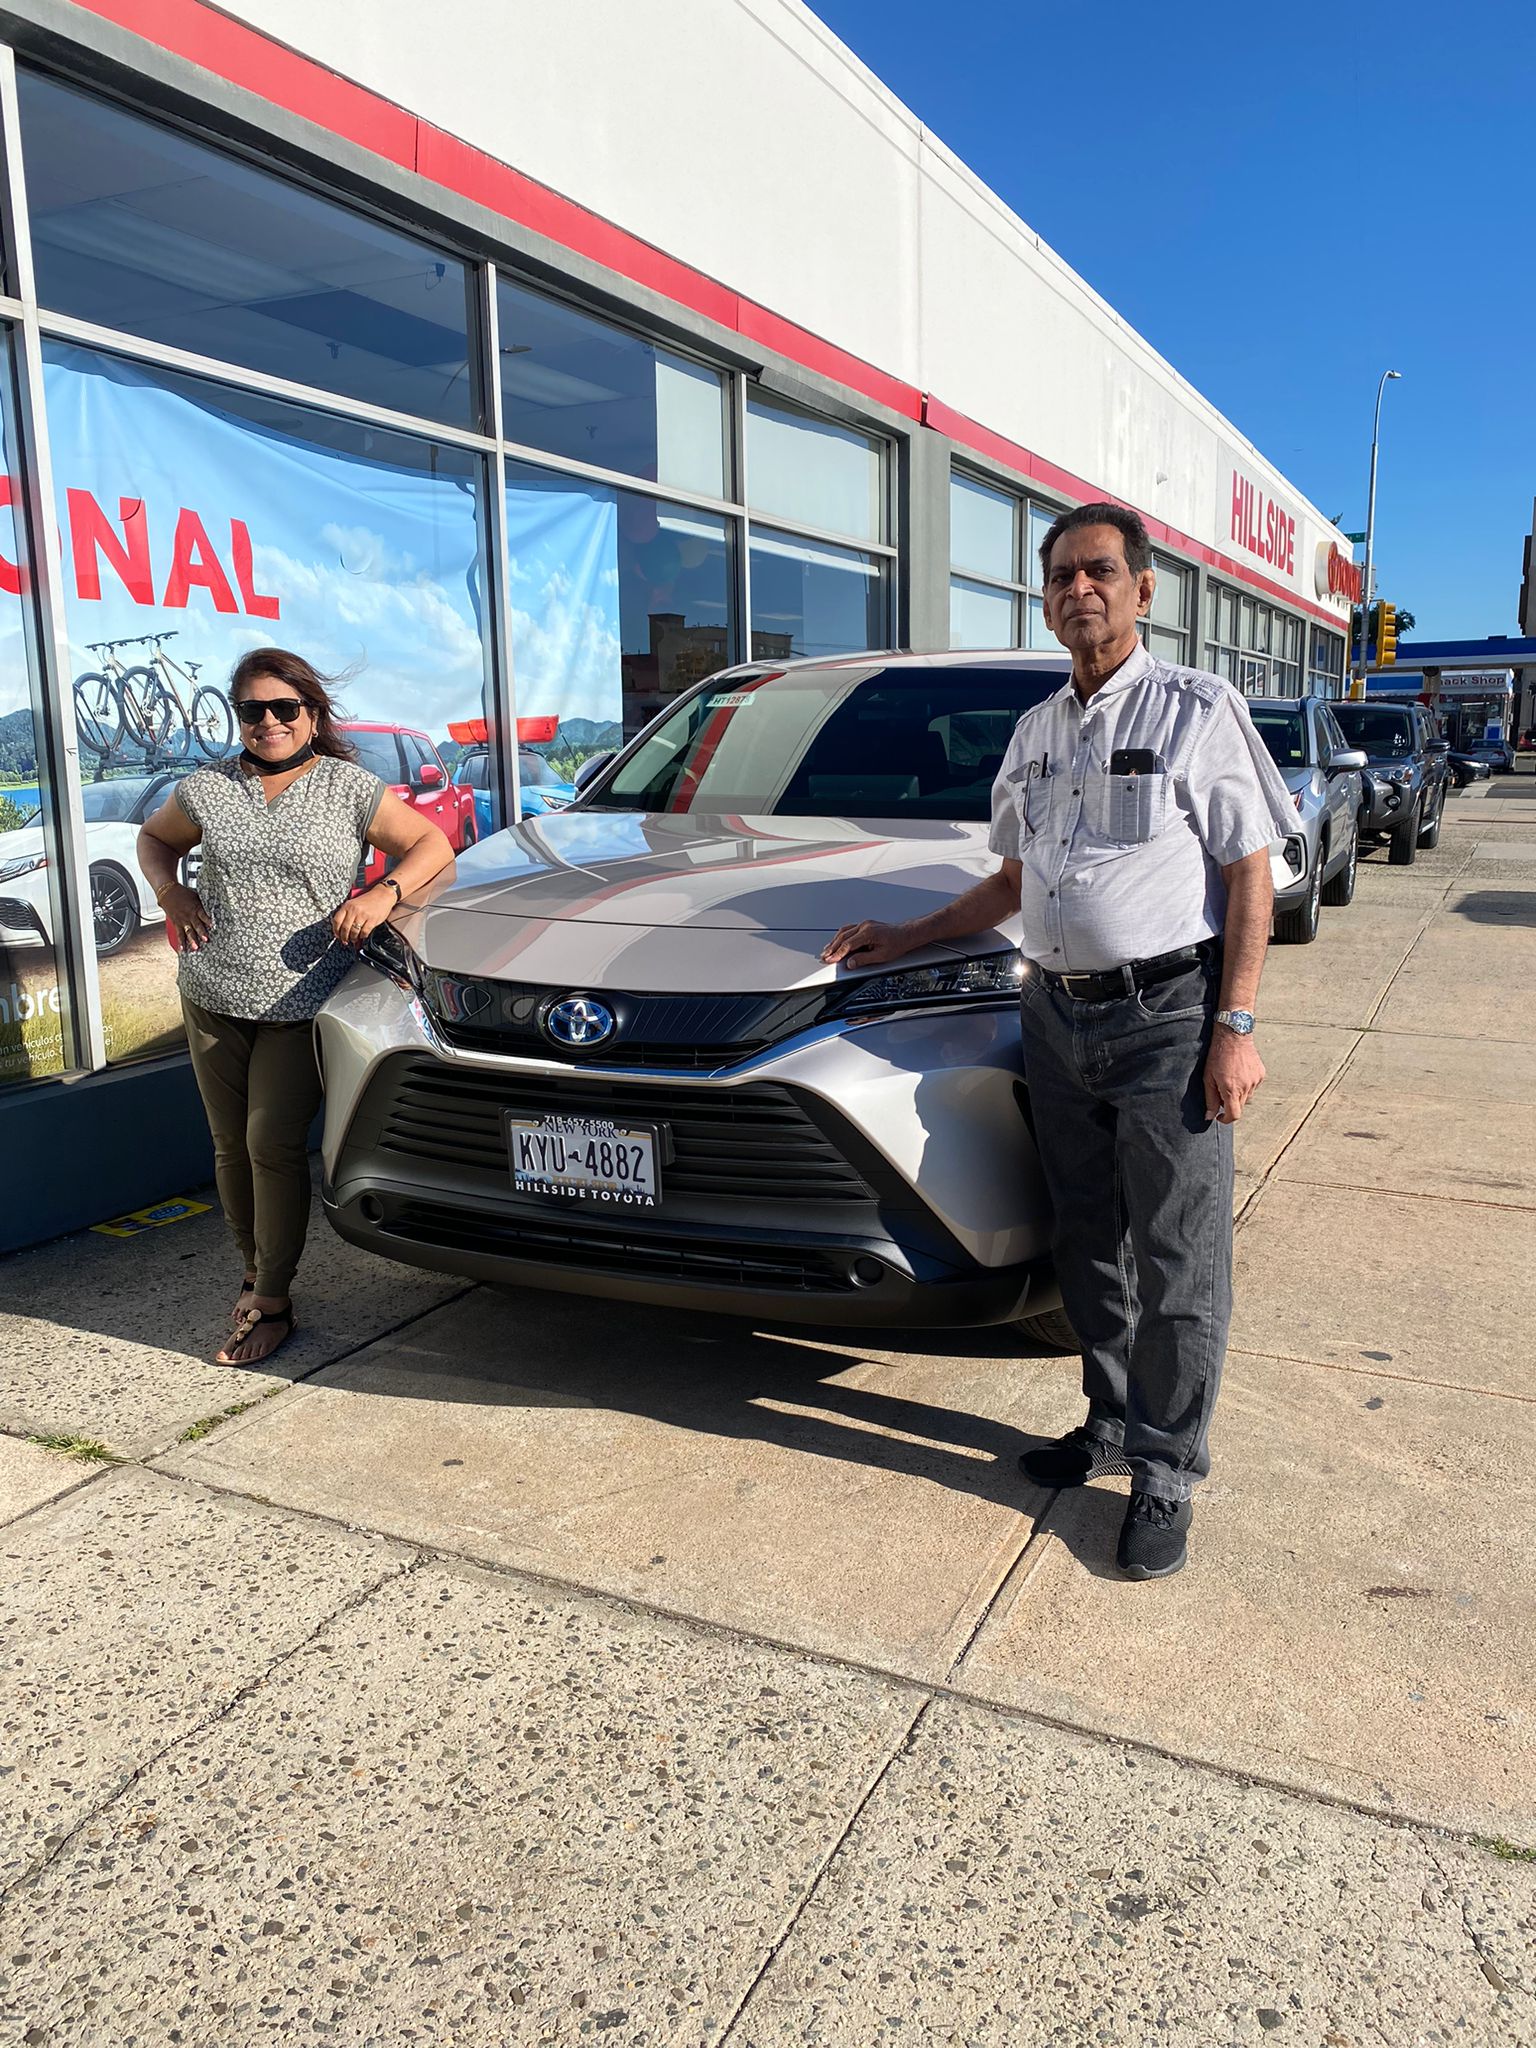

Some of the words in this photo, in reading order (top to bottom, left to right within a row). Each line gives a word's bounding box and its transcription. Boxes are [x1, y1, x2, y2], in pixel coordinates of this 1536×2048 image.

[1231, 469, 1295, 576] HILLSIDE
[1471, 676, 1505, 685] Shop
[544, 1115, 615, 1129] 718-657-5500
[544, 1122, 576, 1135] NEW
[581, 1126, 618, 1139] YORK
[515, 1181, 586, 1198] HILLSIDE
[591, 1189, 655, 1206] TOYOTA
